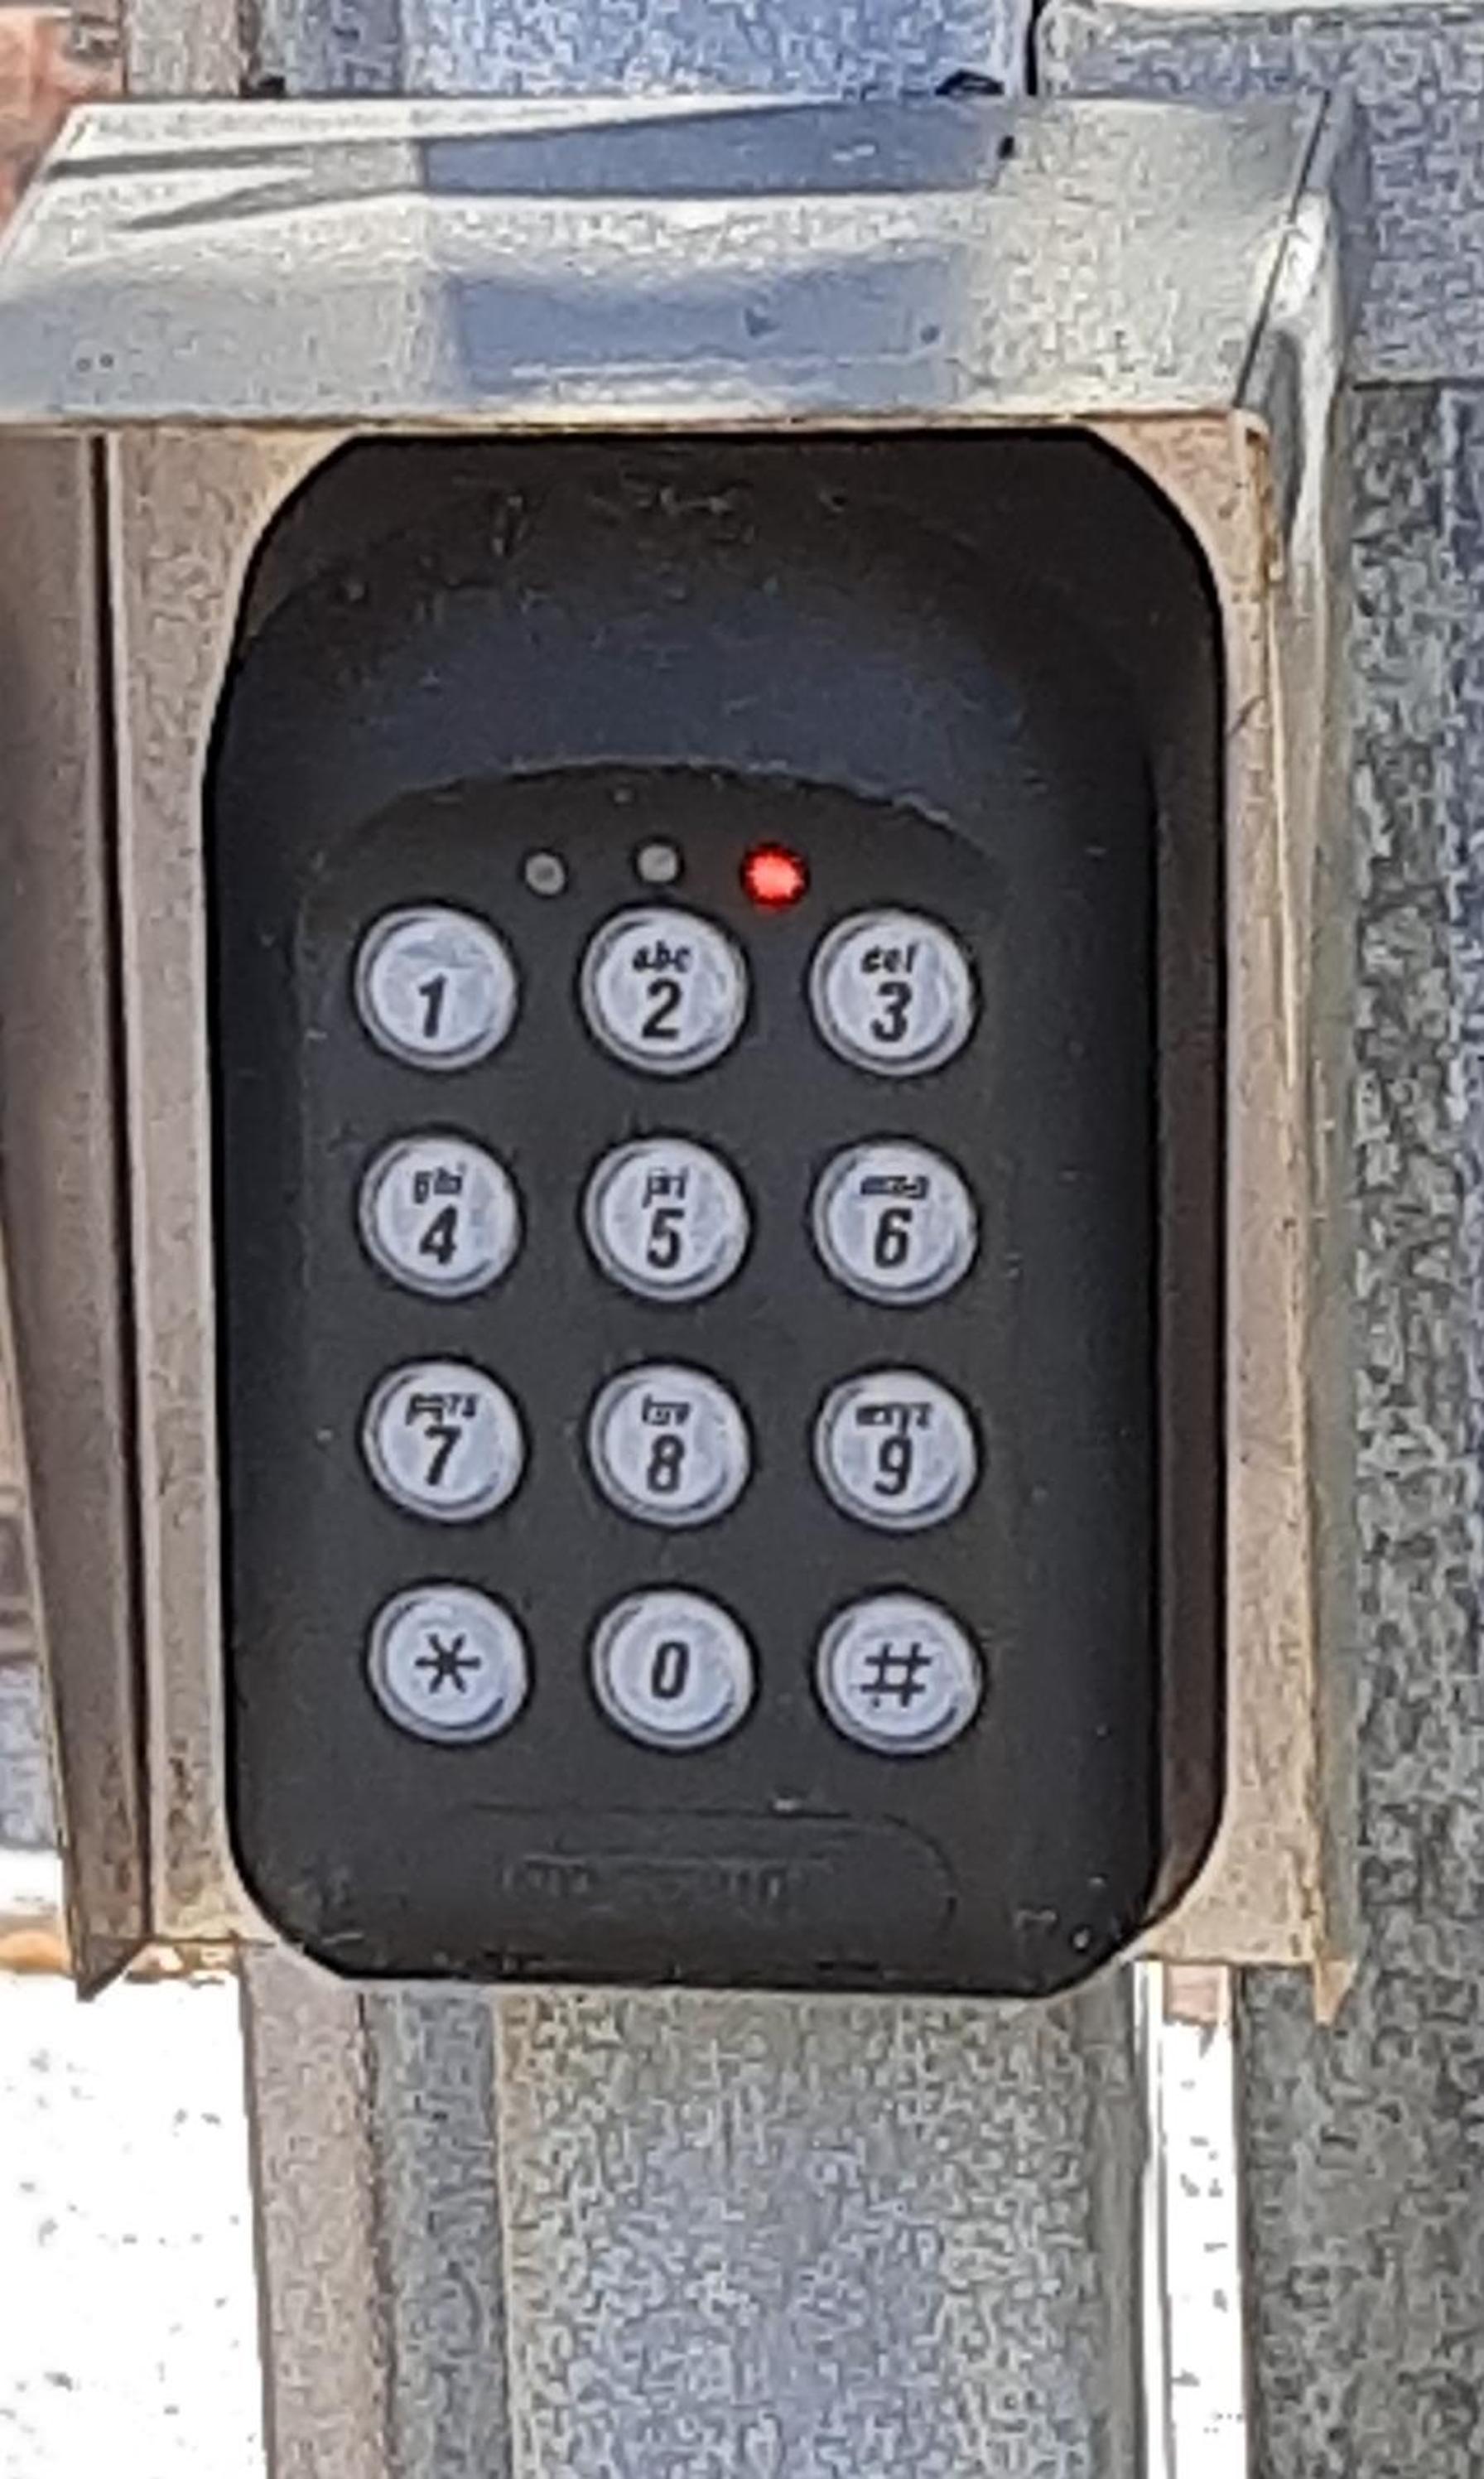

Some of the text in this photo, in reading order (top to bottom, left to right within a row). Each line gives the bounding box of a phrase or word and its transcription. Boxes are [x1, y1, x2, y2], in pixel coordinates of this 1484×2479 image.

[632, 940, 691, 973] abc
[418, 975, 447, 1039] 1
[641, 977, 682, 1040] 2
[870, 981, 913, 1044] 3
[419, 1205, 458, 1266] 4
[647, 1208, 685, 1270] 5
[874, 1207, 913, 1270] 6
[424, 1424, 462, 1487] 7
[646, 1434, 686, 1494] 8
[874, 1435, 913, 1497] 9
[651, 1641, 690, 1700] 0
[860, 1642, 932, 1708] #
